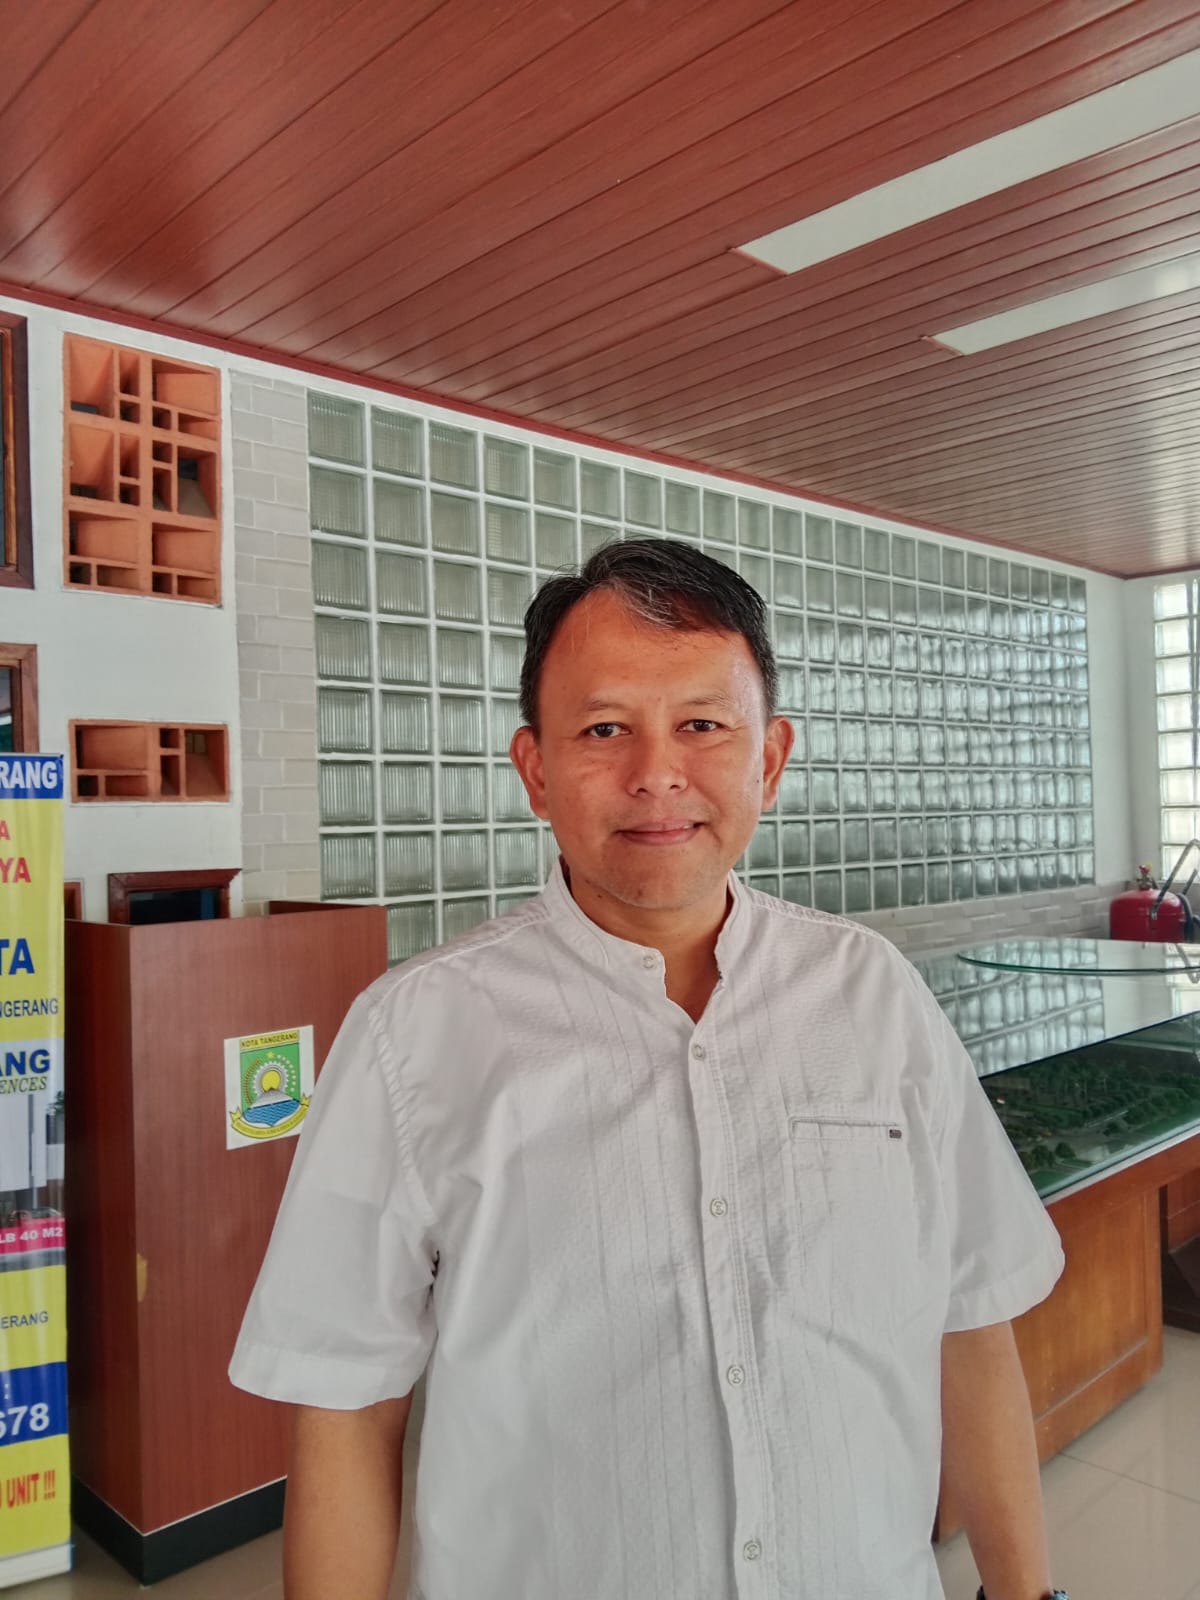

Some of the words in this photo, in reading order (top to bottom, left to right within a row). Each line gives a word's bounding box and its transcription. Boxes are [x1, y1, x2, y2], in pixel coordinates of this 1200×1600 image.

[0, 998, 58, 1018] GERANG
[0, 1049, 50, 1077] NG
[20, 1230, 39, 1241] 40
[42, 1227, 63, 1238] M2
[6, 1472, 40, 1509] UNIT
